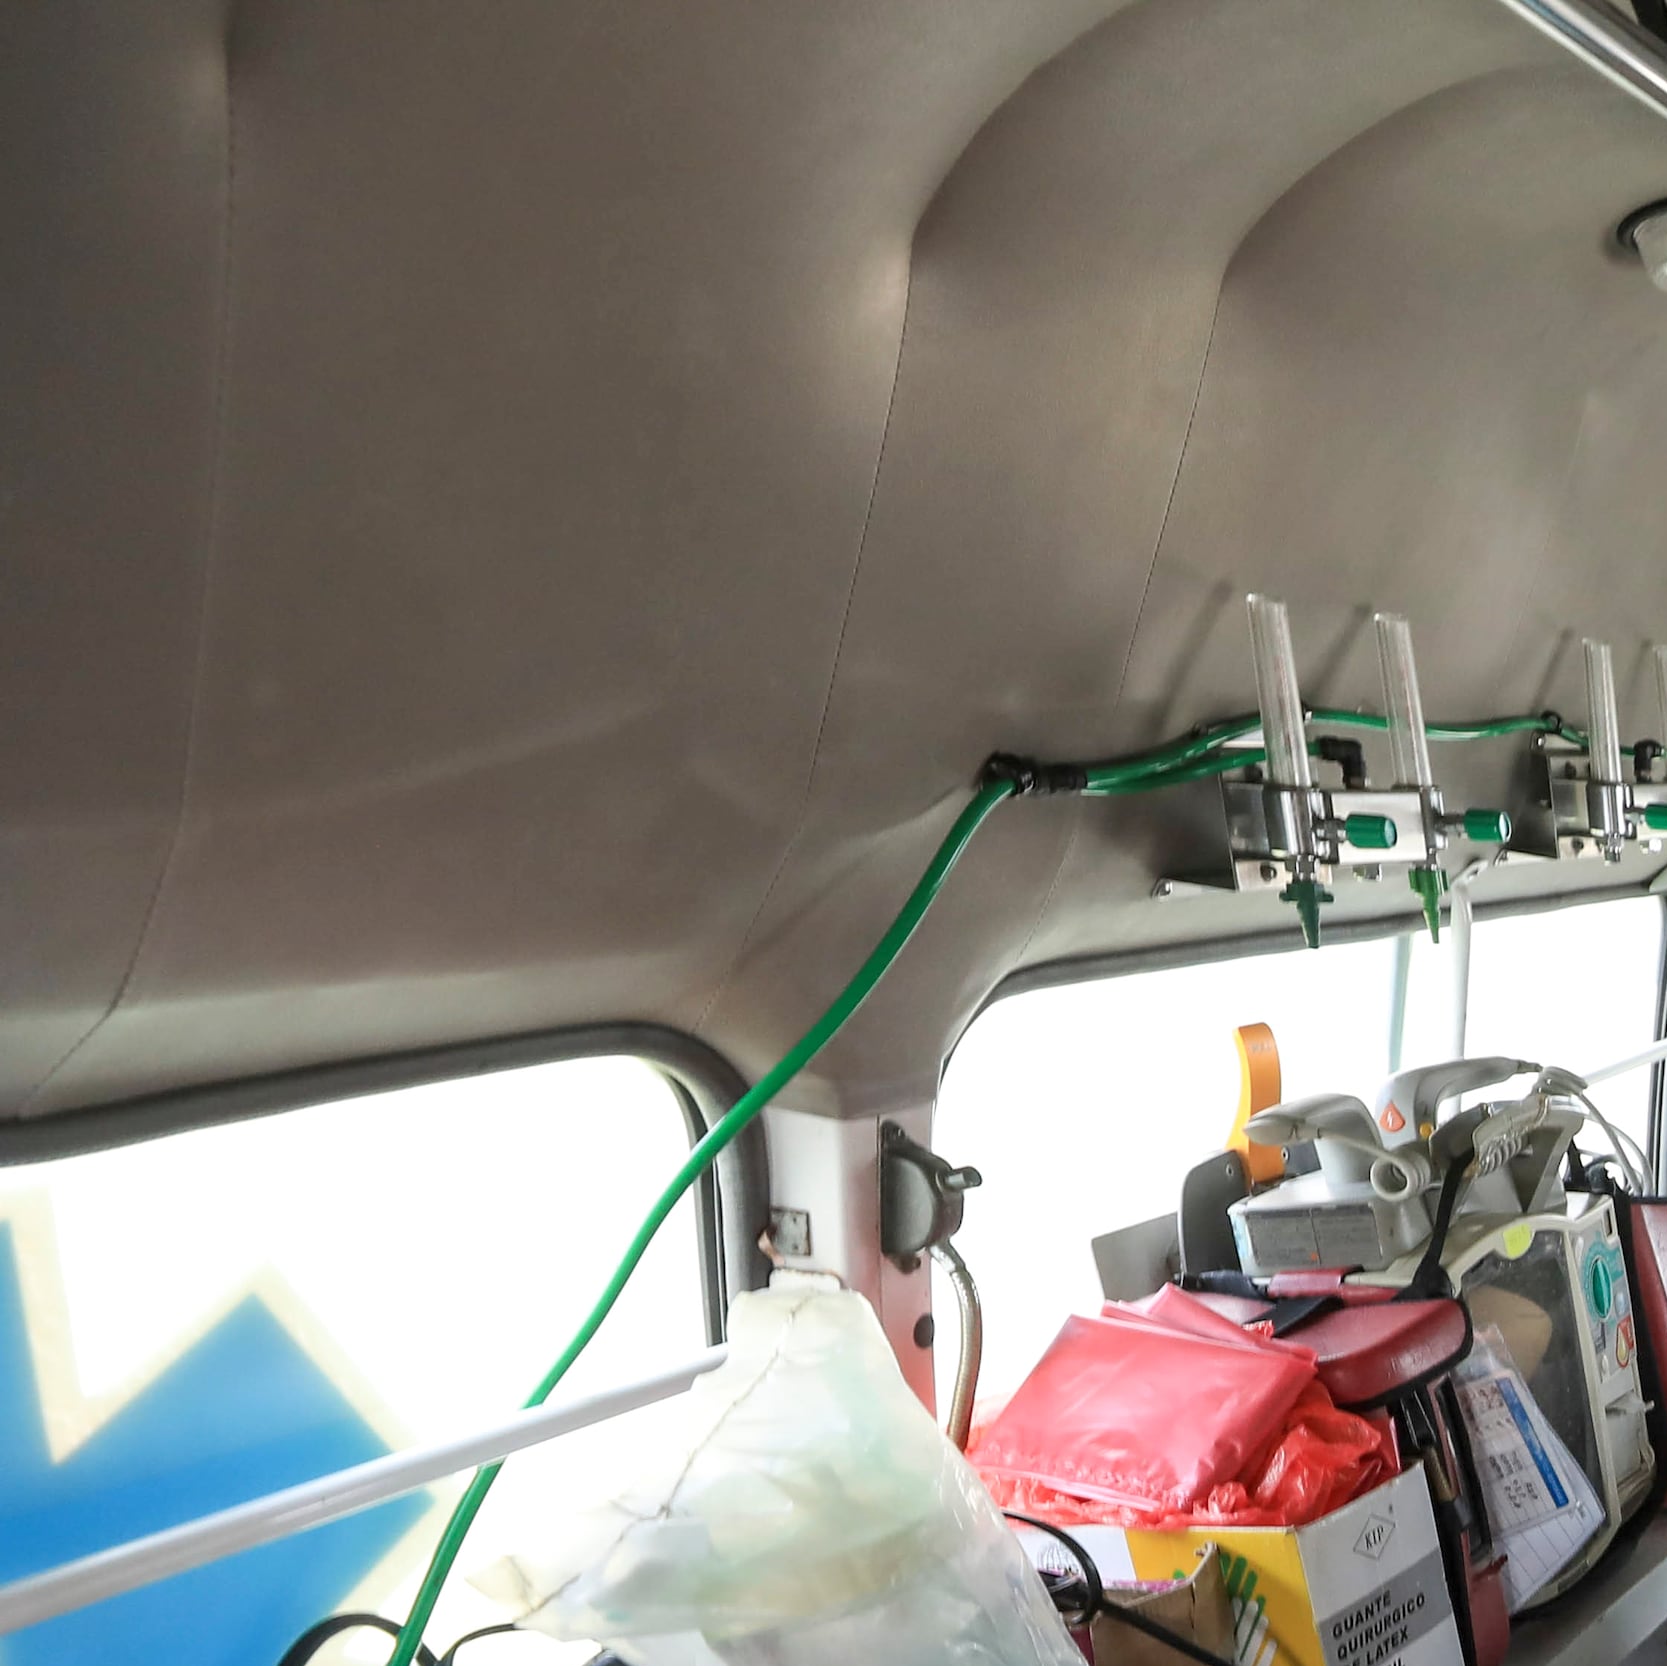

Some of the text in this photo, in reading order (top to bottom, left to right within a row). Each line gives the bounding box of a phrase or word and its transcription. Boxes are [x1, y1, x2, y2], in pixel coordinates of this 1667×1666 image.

[1365, 1524, 1385, 1551] KIP
[1332, 1589, 1392, 1639] GUANTE
[1337, 1592, 1426, 1661] QUIRURGICO
